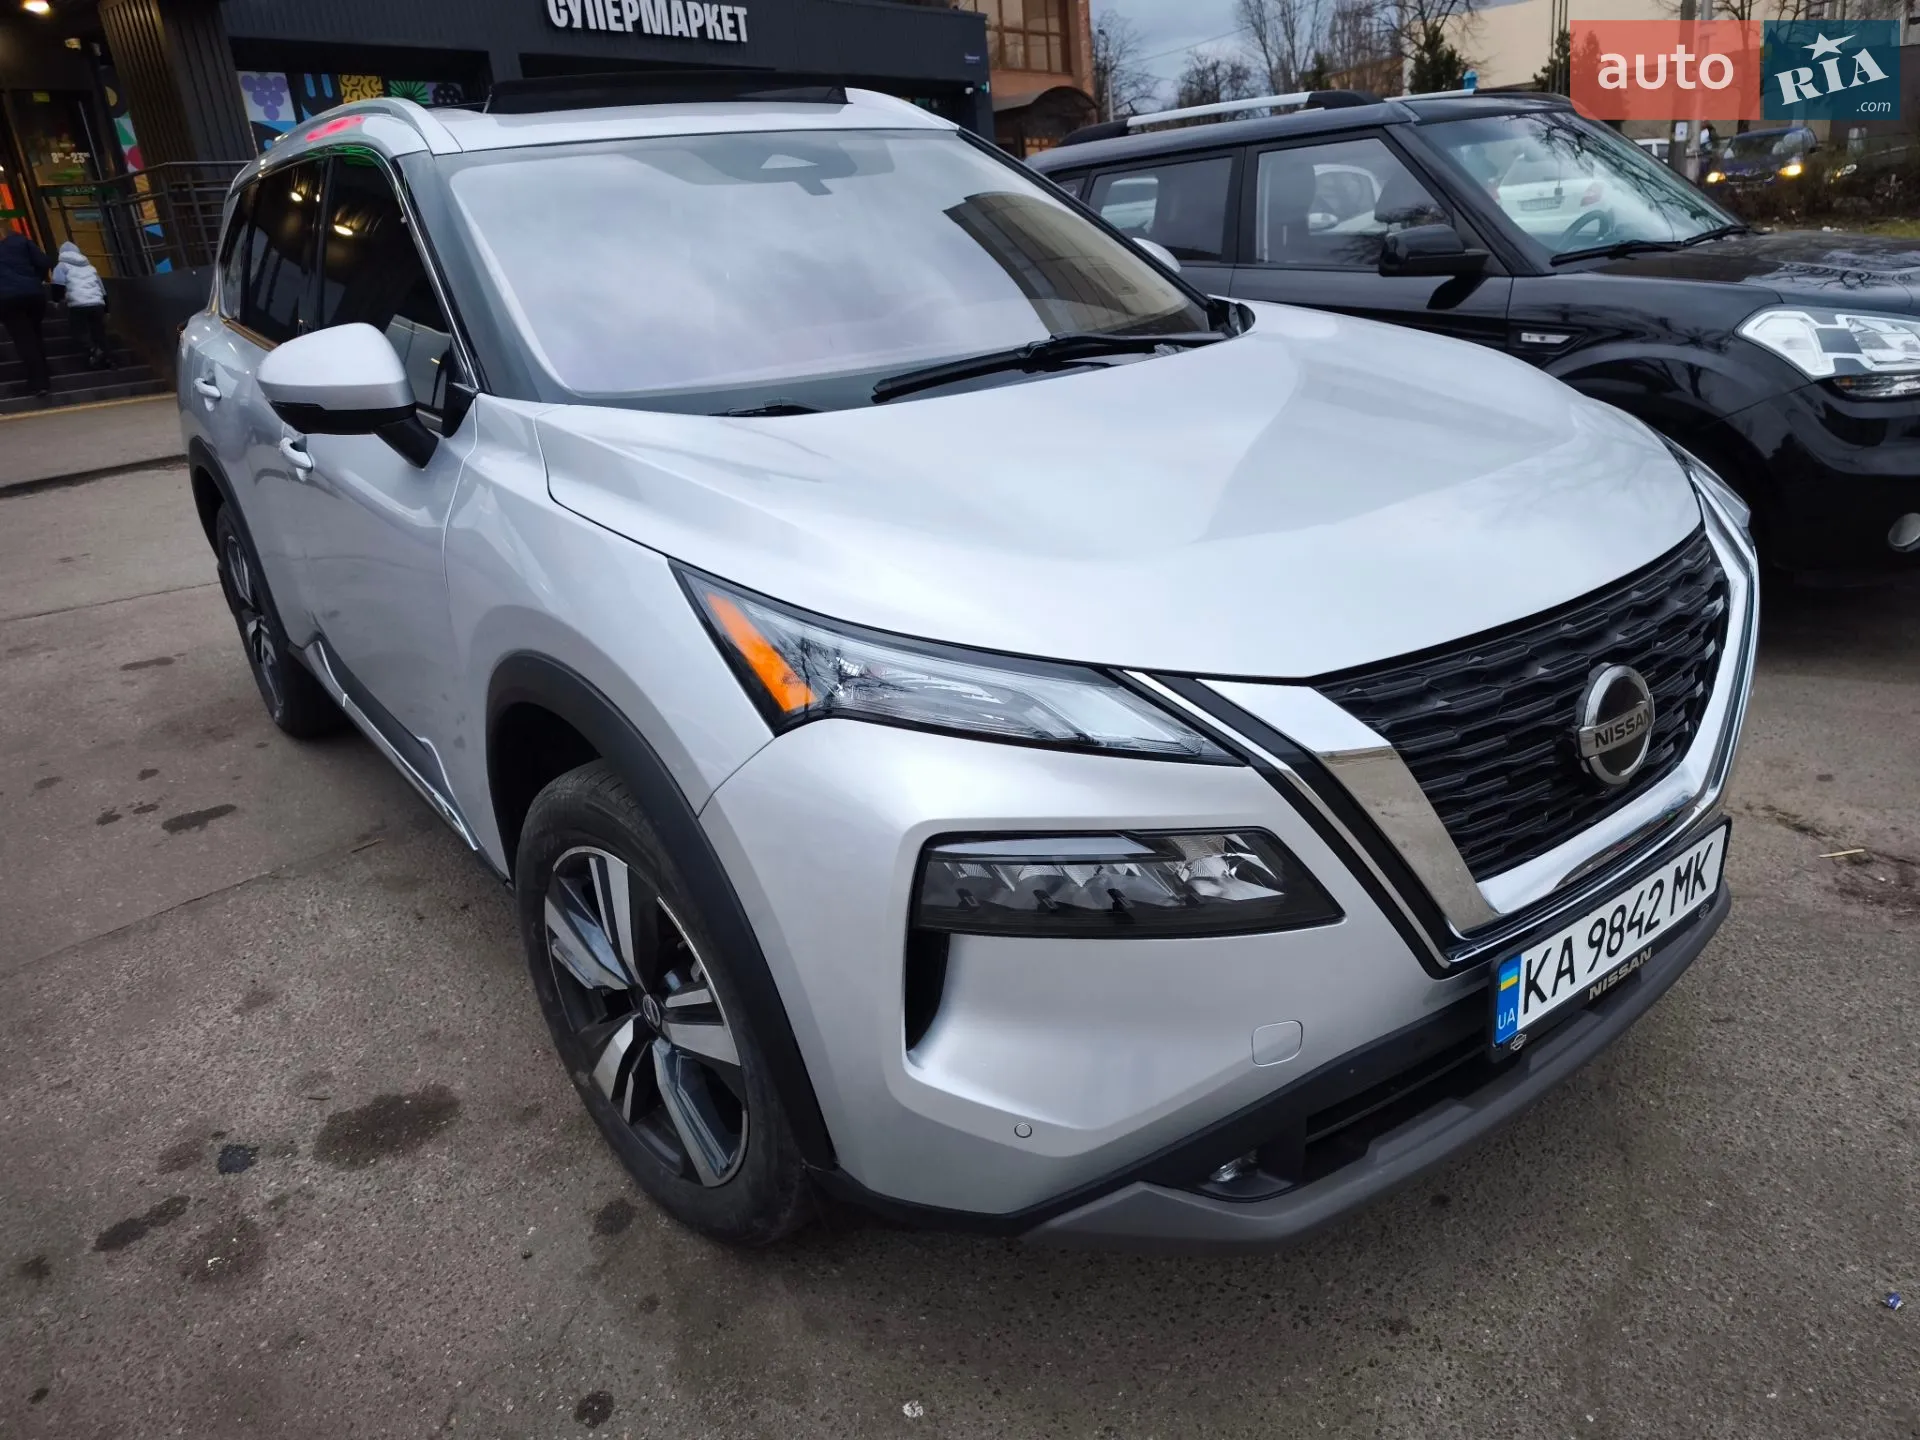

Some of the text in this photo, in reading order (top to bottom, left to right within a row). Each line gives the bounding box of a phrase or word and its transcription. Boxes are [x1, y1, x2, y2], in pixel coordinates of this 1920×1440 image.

[547, 0, 748, 42] СУПЕРМАРКЕТ
[1594, 708, 1650, 748] NISSAN
[1523, 841, 1714, 1015] KA 9842 MK
[1588, 947, 1652, 1000] NISSAN
[1497, 1010, 1516, 1030] UA
